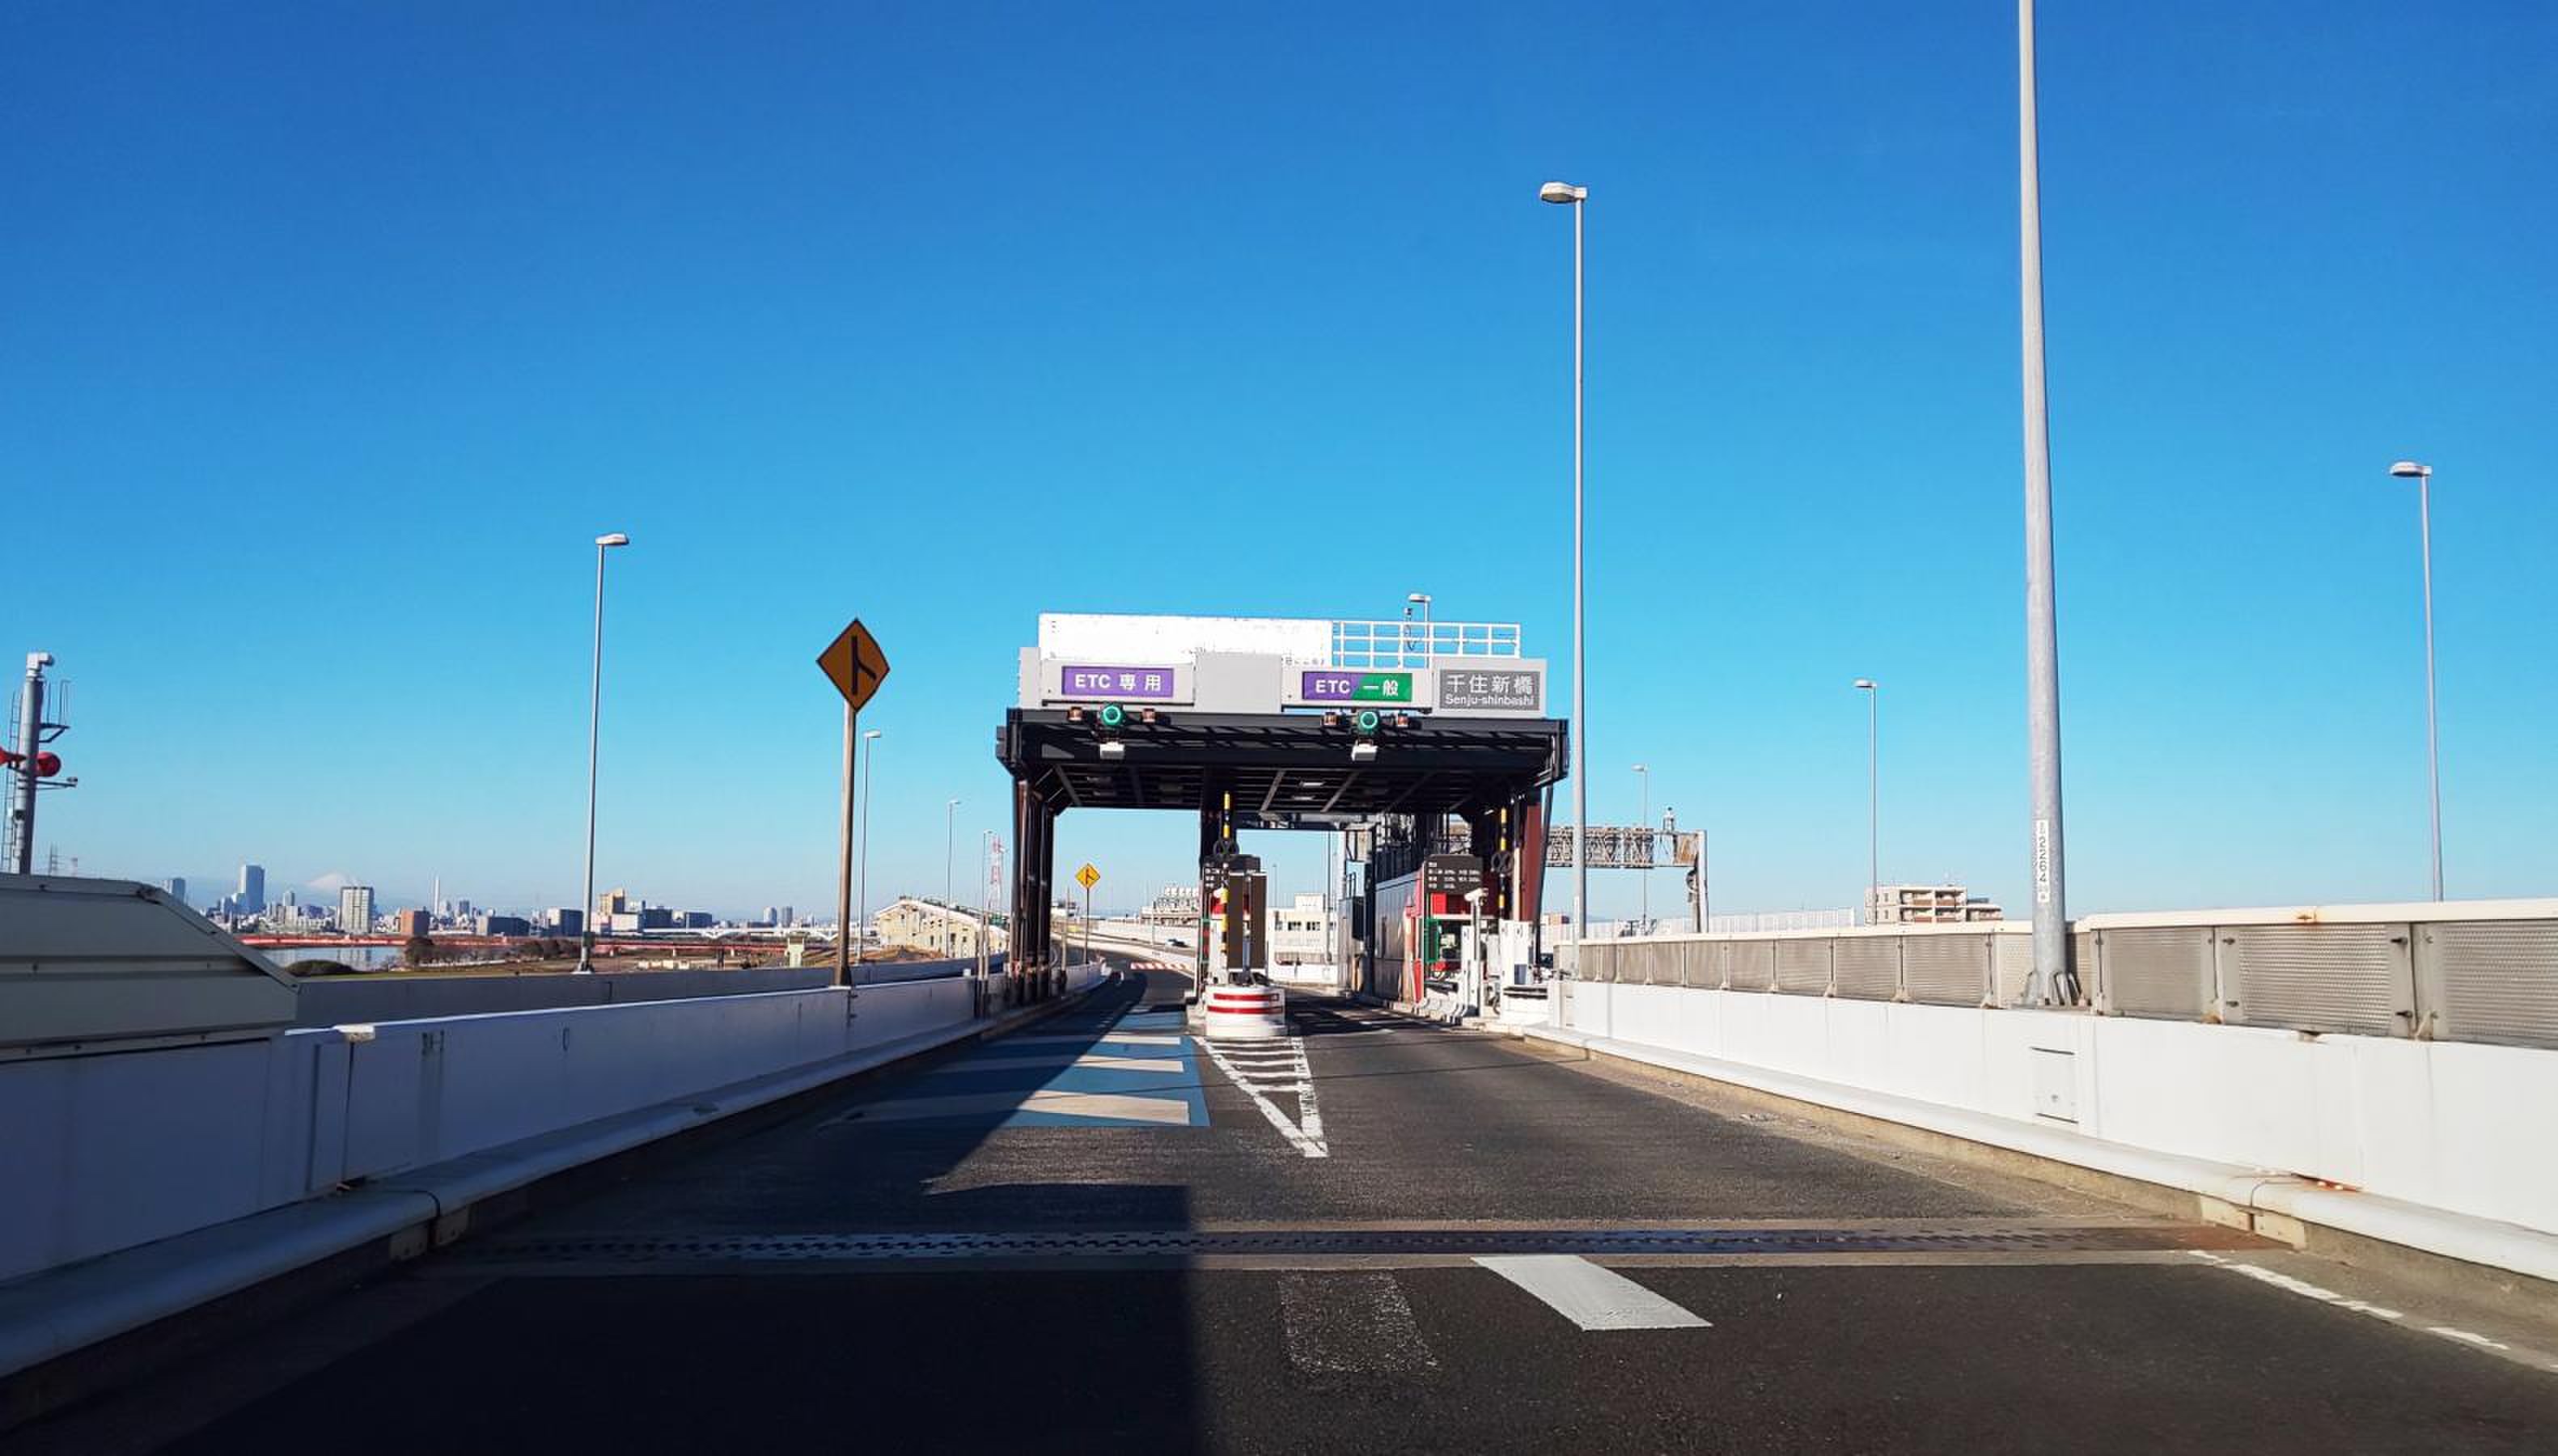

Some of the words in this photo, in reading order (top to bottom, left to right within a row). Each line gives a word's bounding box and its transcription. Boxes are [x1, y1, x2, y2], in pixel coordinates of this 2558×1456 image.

[1074, 674, 1111, 688] ETC
[1119, 673, 1161, 692] 専用
[1315, 679, 1350, 694] ETC
[1362, 679, 1399, 696] 一般
[1446, 674, 1533, 694] 千住新橋
[1445, 693, 1534, 707] Senju-shinbashi
